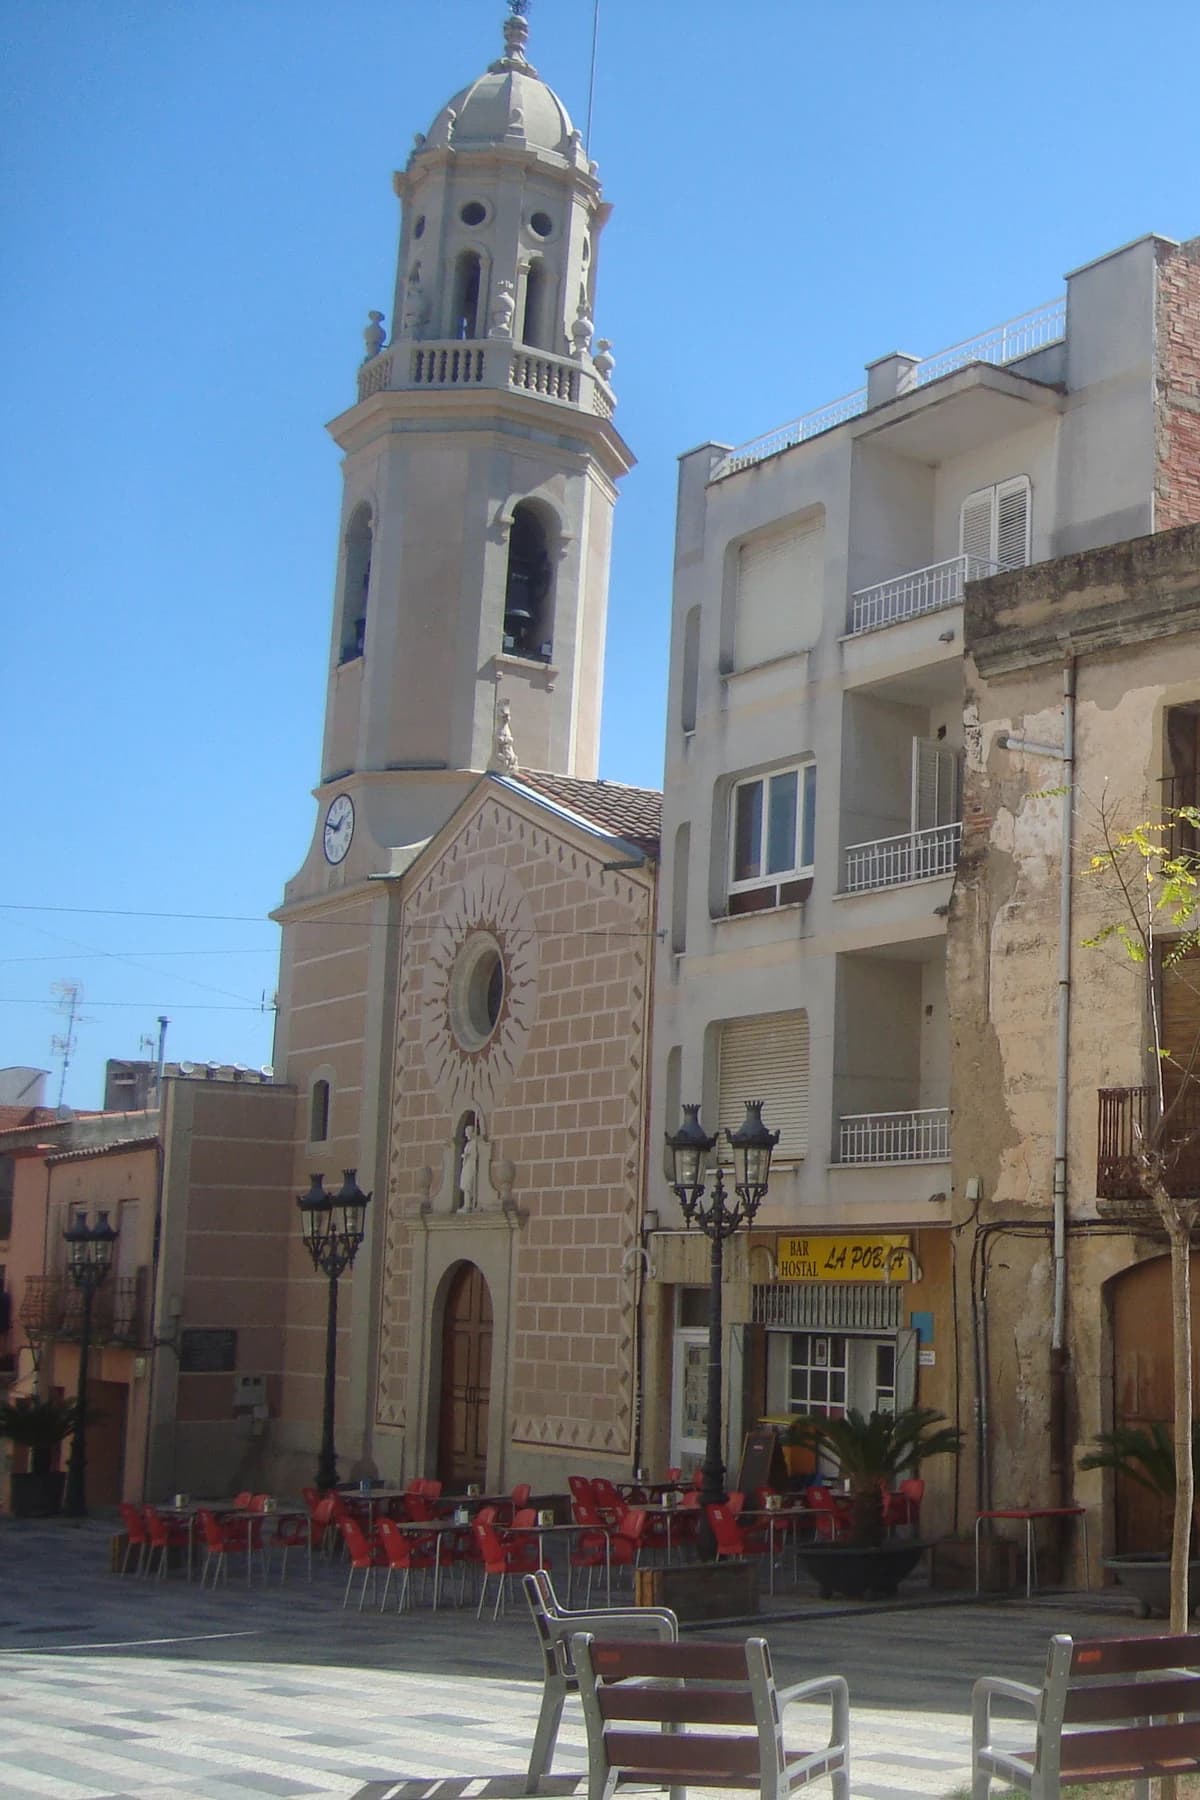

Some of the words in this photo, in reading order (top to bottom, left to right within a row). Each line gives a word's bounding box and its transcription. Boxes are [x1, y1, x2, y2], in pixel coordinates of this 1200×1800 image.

[790, 1240, 808, 1256] BAR
[824, 1245, 847, 1270] LA
[781, 1261, 818, 1277] HOSTAL
